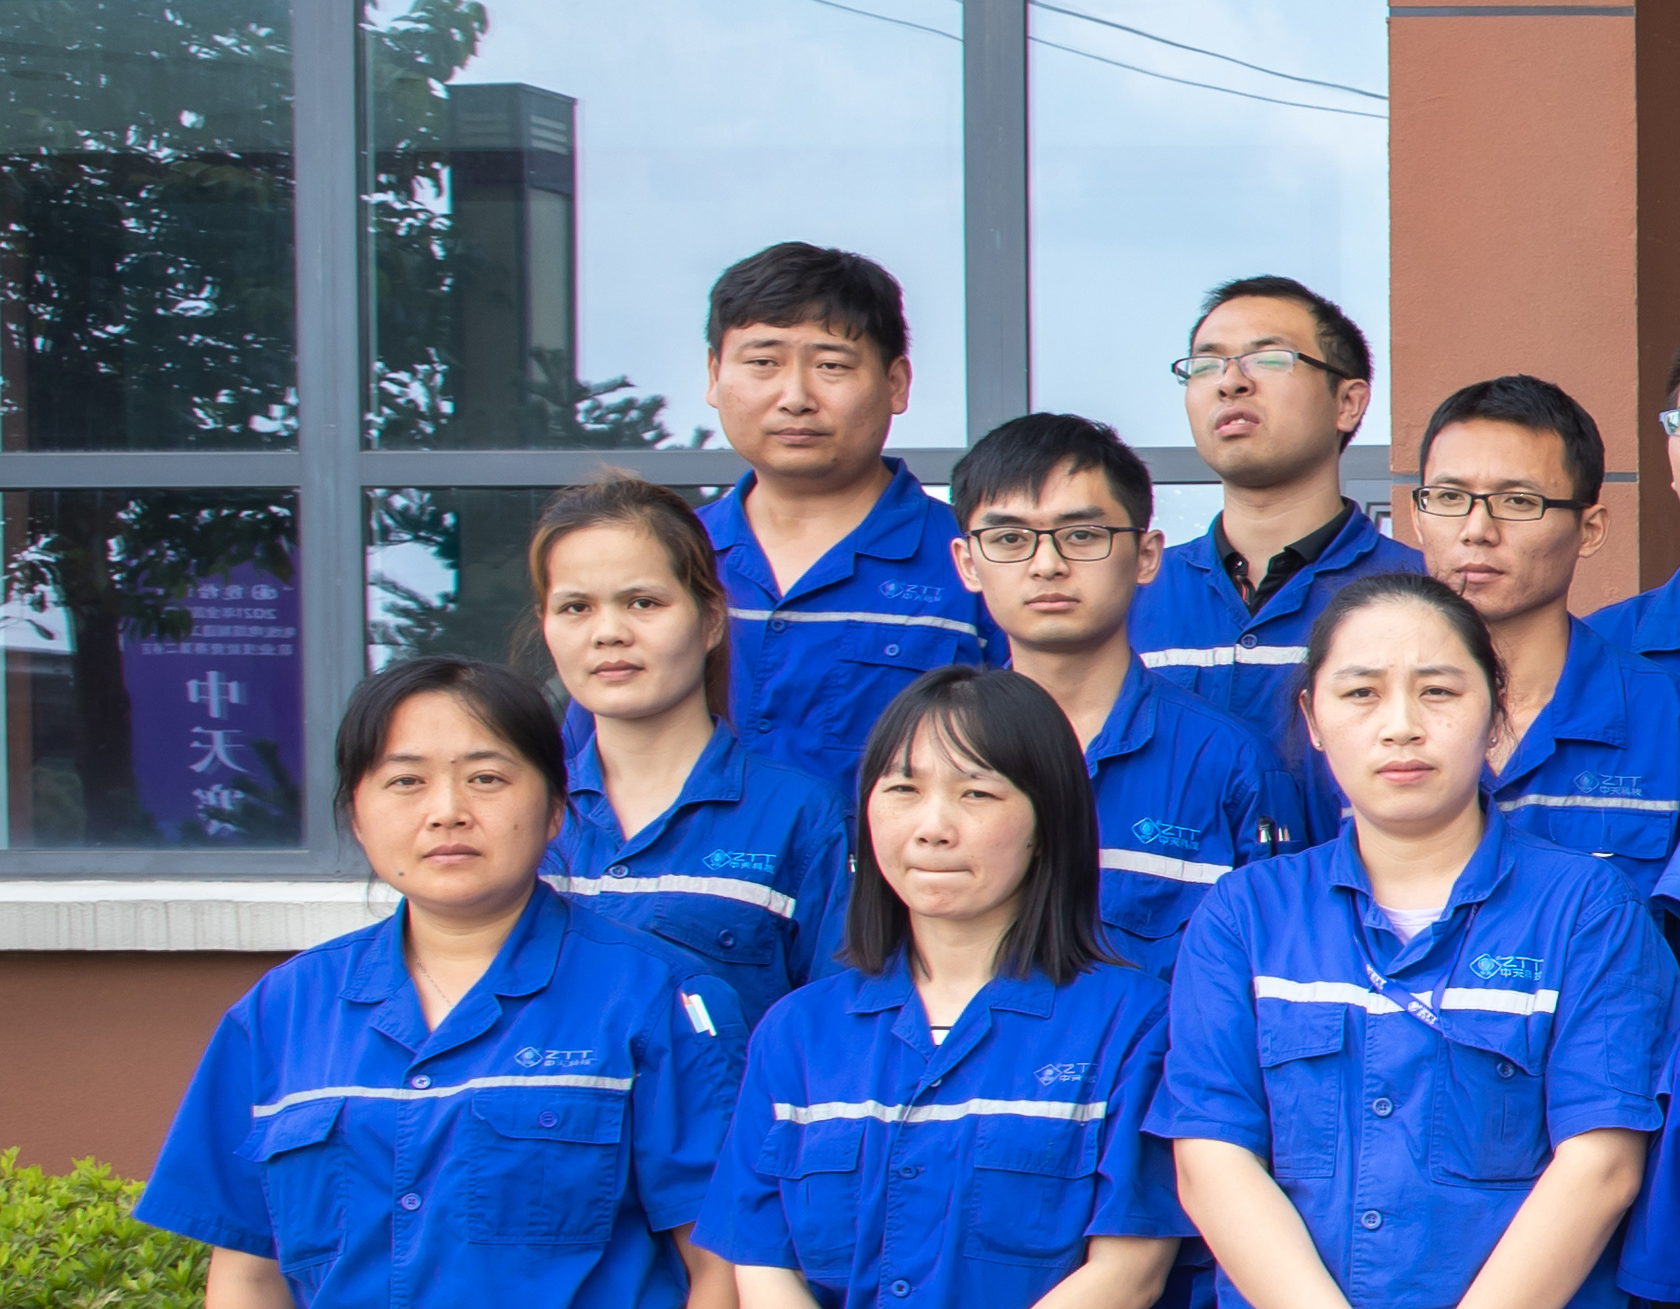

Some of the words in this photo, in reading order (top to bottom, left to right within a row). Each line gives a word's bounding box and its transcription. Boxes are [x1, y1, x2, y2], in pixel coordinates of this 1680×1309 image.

[1599, 774, 1642, 786] ZTT
[1161, 823, 1201, 841] ZTT
[733, 853, 776, 863] ZTT
[1501, 956, 1544, 971] ZTT
[545, 1050, 593, 1060] ZTT
